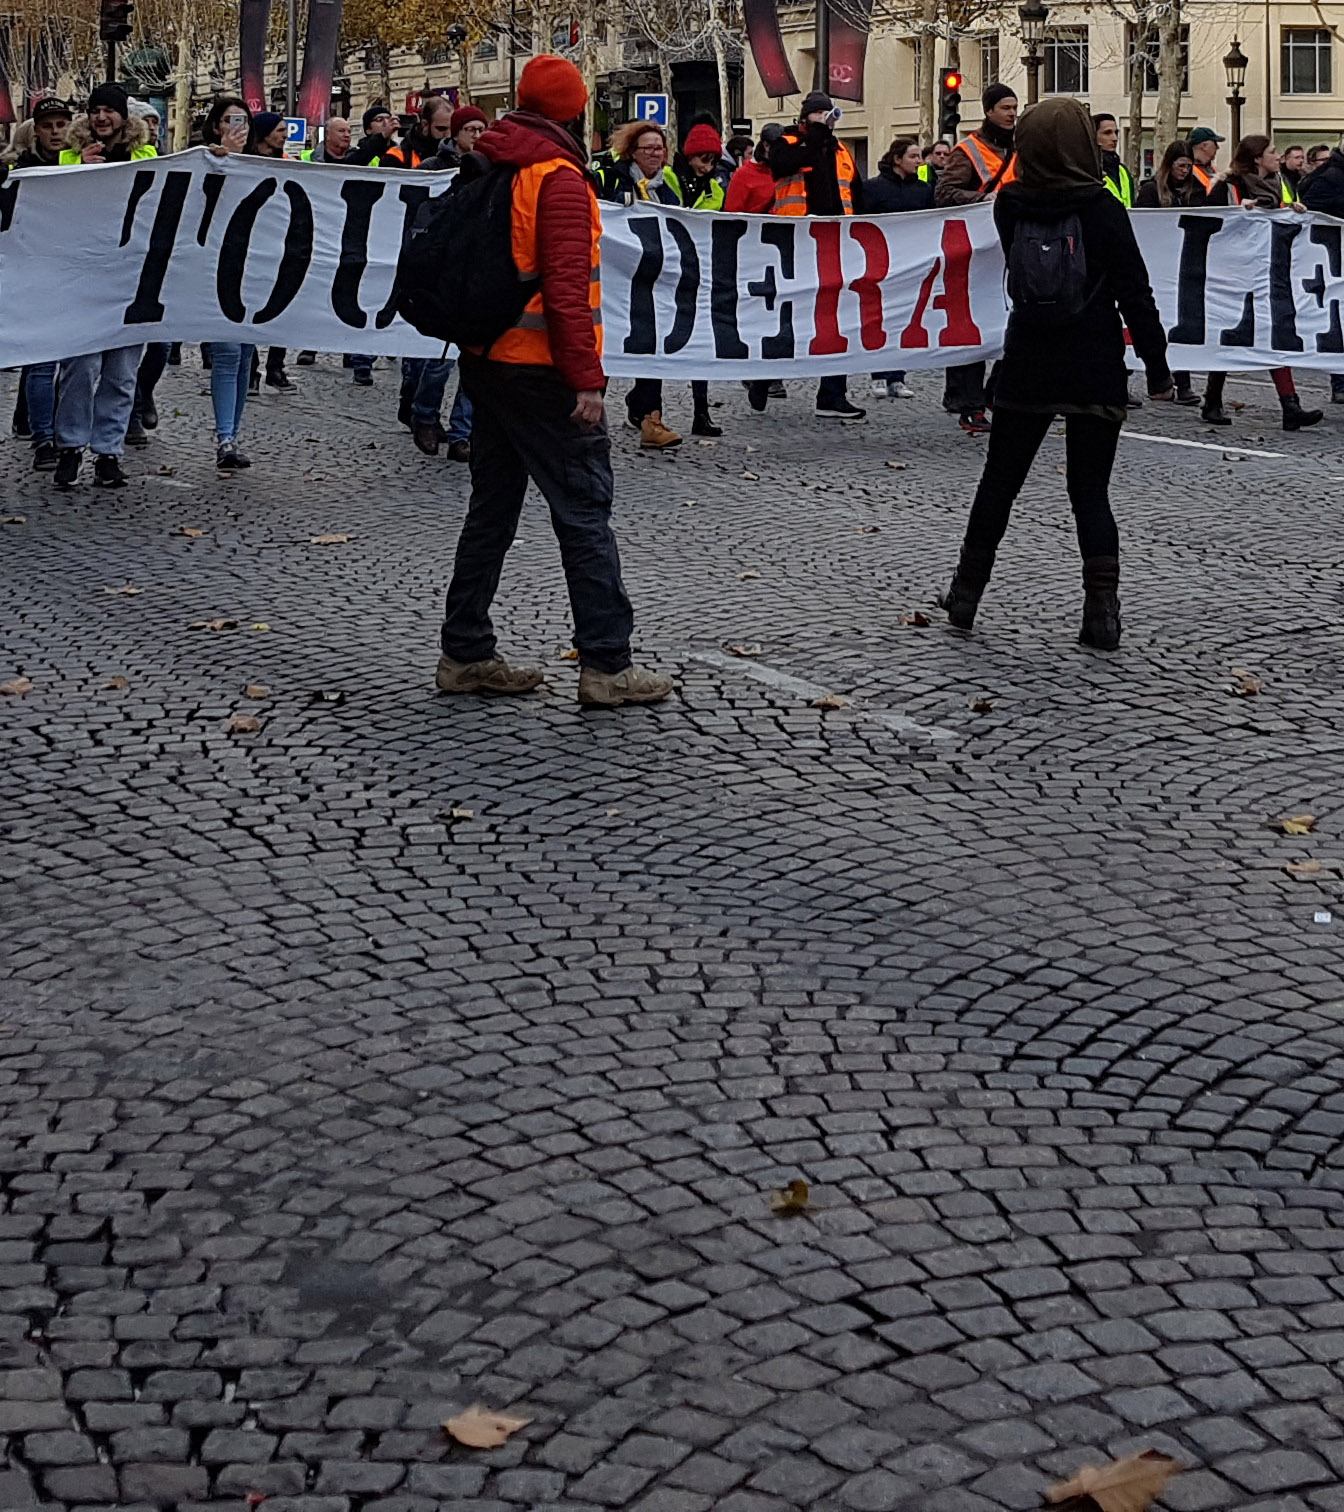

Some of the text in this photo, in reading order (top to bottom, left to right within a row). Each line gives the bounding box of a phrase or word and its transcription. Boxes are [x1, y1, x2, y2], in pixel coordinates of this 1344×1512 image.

[645, 100, 659, 120] P
[287, 122, 299, 135] P
[119, 170, 436, 330] TOU
